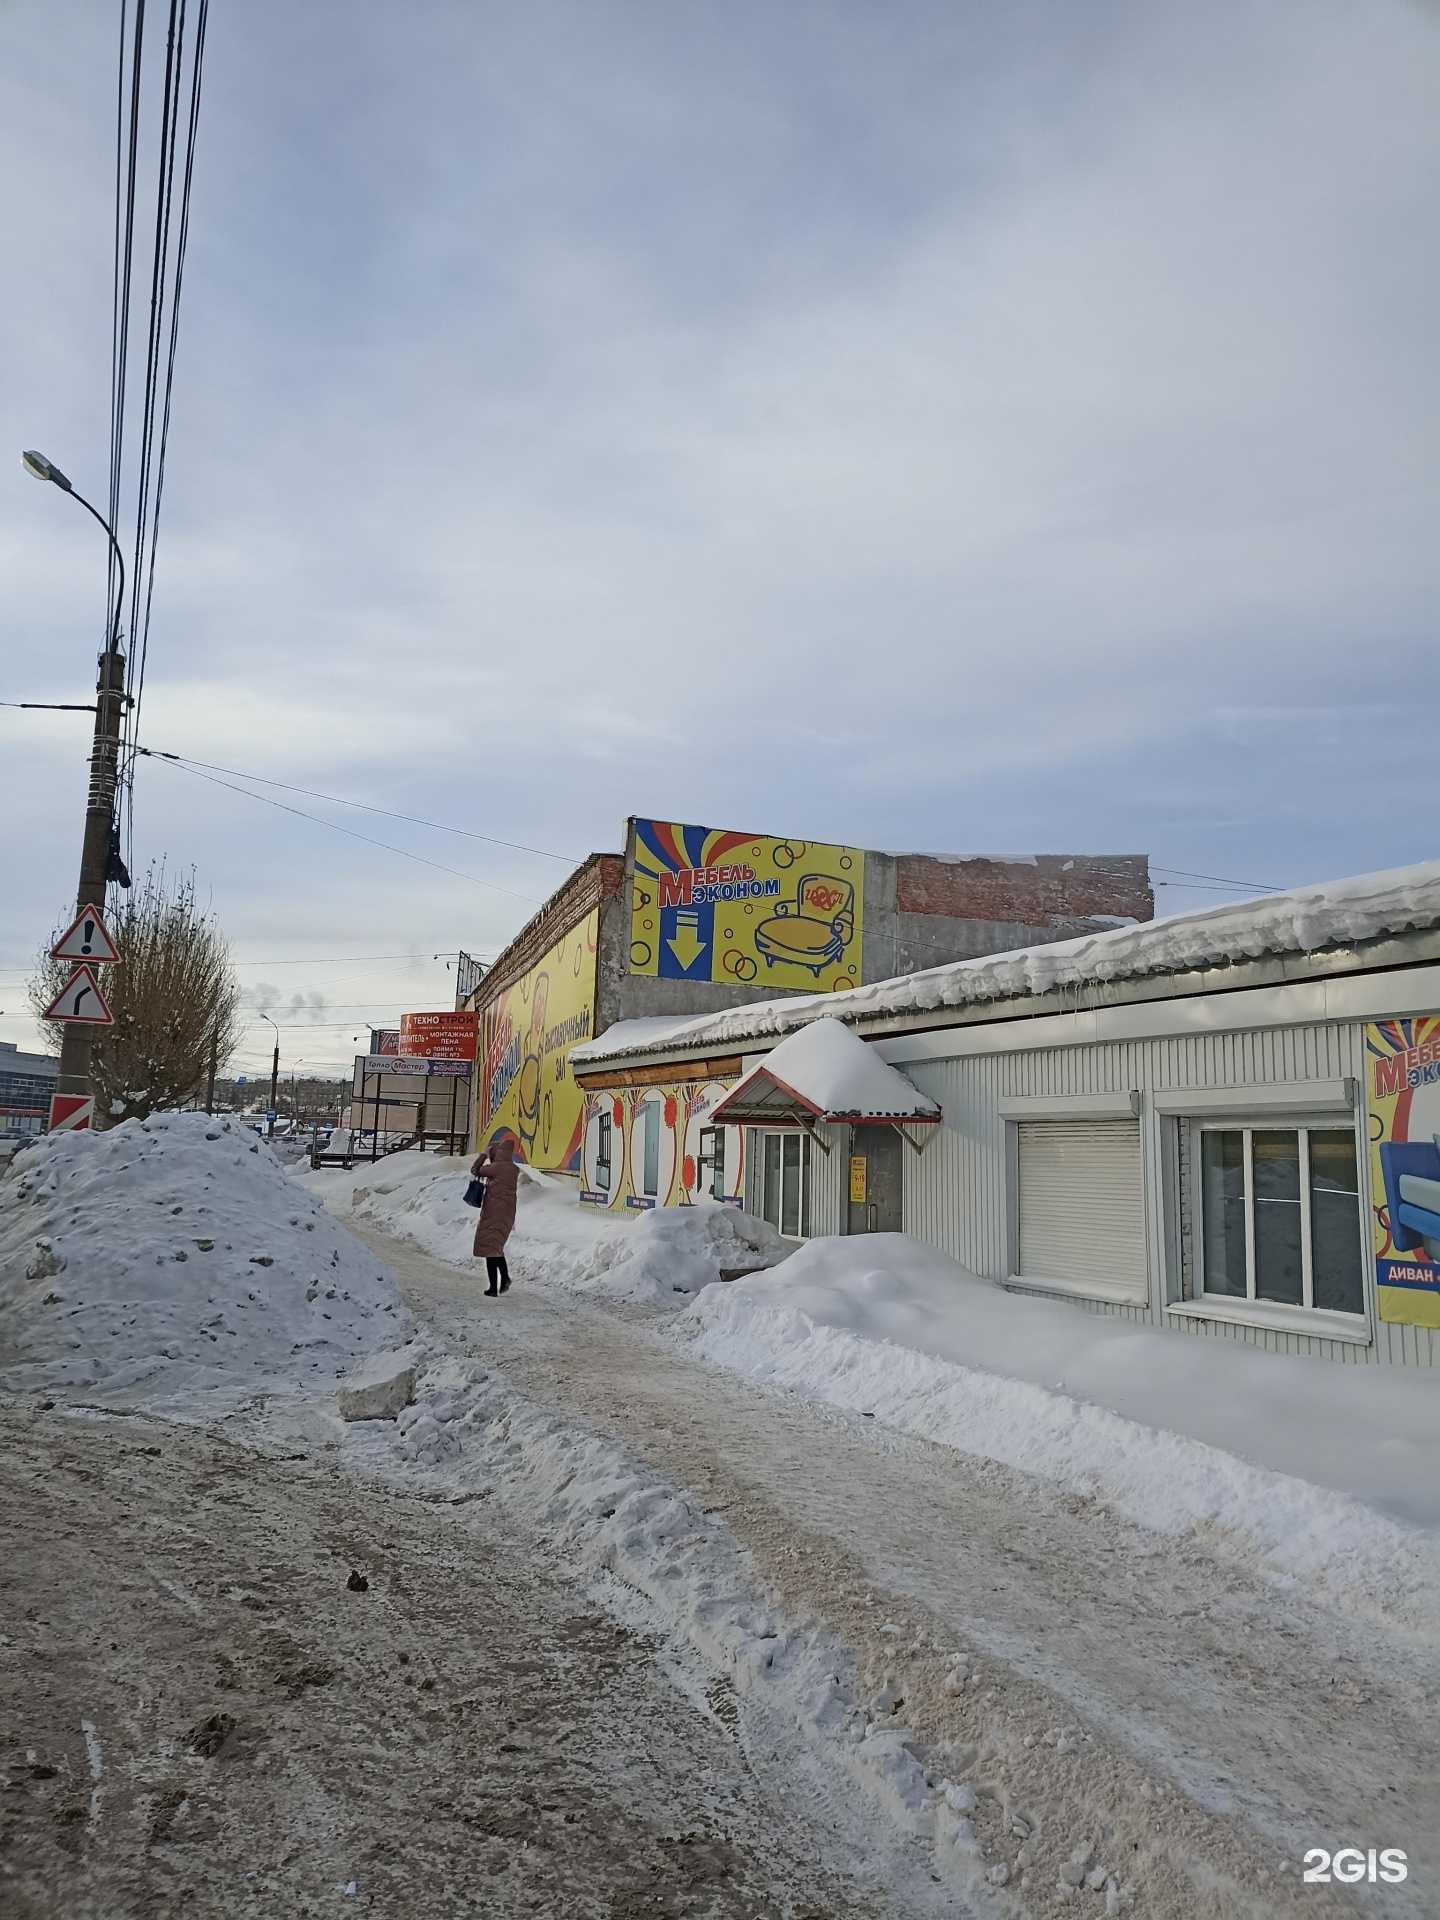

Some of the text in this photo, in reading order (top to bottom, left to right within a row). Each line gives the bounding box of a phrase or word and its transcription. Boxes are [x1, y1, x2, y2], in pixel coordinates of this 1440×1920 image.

[658, 864, 756, 908] МЕБЕЛЬ
[692, 879, 781, 903] ЭКОНОМ
[556, 1056, 566, 1081] ЗАЛ
[1389, 1266, 1434, 1282] ДИВАН
